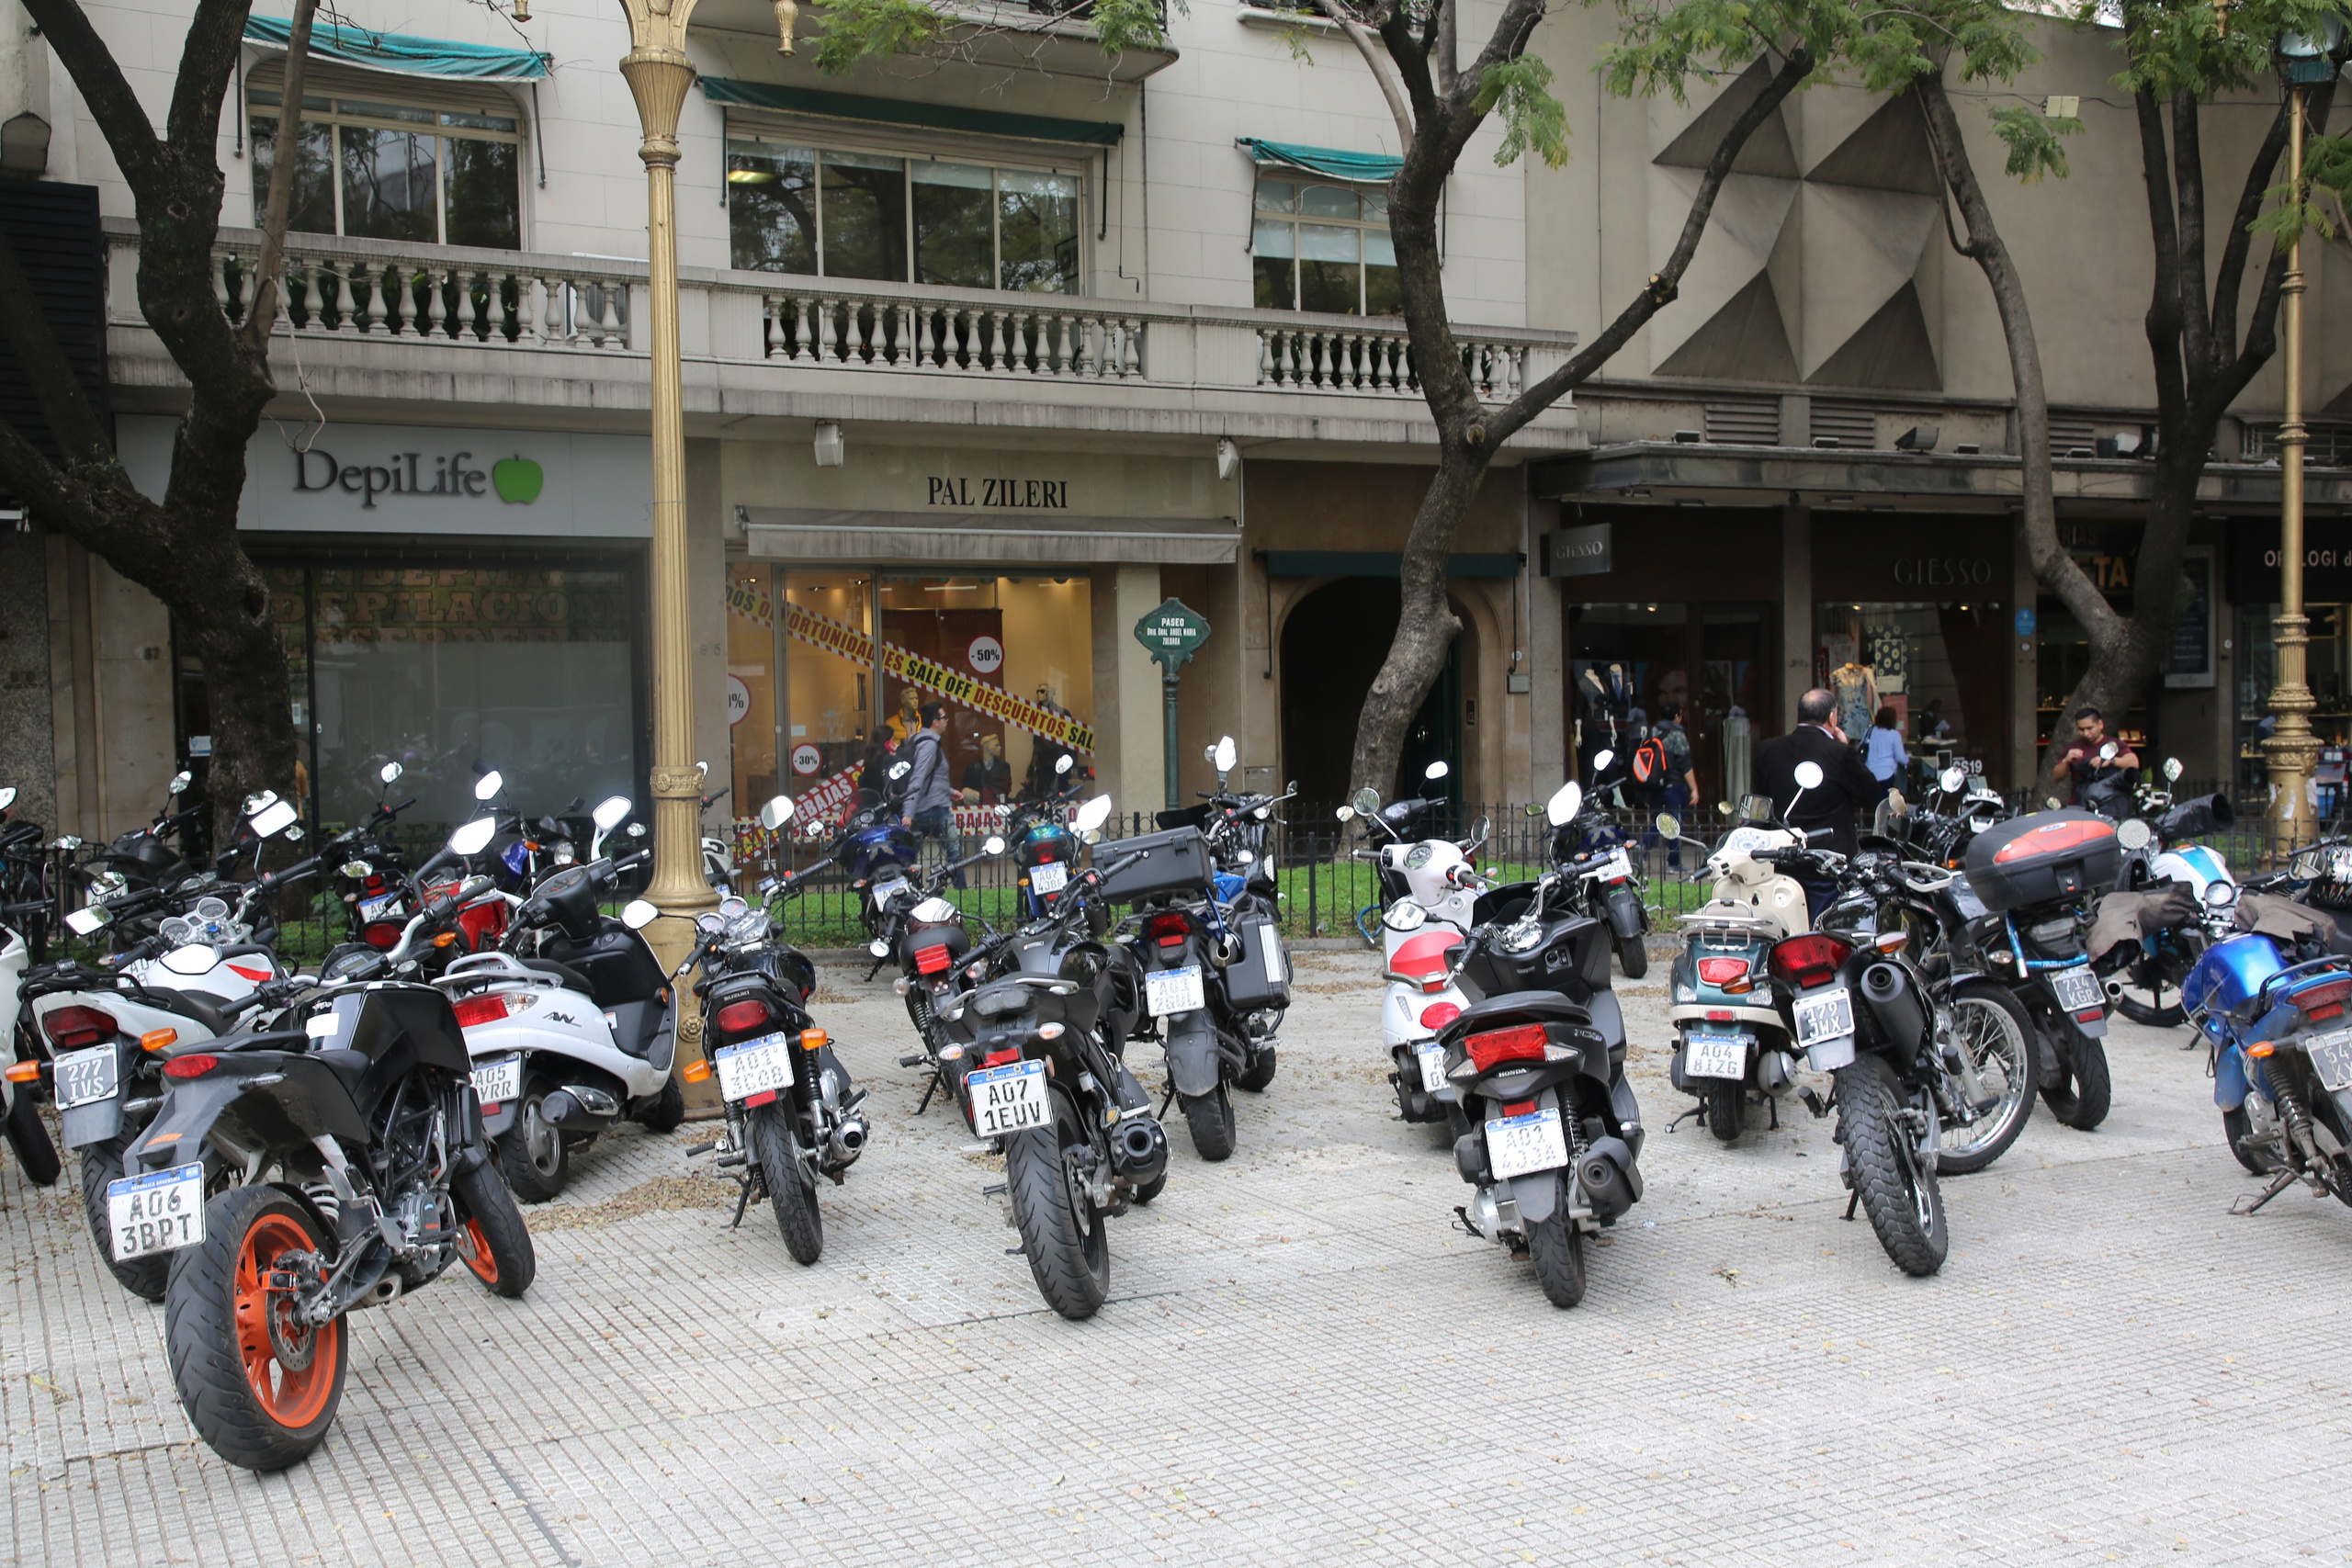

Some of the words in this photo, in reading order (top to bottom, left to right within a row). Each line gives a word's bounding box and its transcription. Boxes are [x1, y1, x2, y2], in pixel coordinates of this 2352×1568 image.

[293, 448, 487, 509] DepiLife
[927, 476, 975, 505] PAL
[982, 478, 1069, 508] ZILERI
[1556, 540, 1603, 559] GIESSO
[2264, 549, 2337, 568] OOGI
[1894, 558, 1992, 585] GIESSO
[1161, 617, 1184, 626] PASEO
[906, 660, 944, 687] SALE
[944, 676, 973, 699] OFF
[973, 686, 1067, 738] DESCUENTOS
[1068, 726, 1094, 751] SAL
[793, 777, 854, 828] EBAJAS
[953, 810, 1003, 829] BAJAS
[723, 989, 750, 1001] SUZUKI
[2062, 978, 2089, 993] 714
[2069, 989, 2096, 1006] KGR
[1805, 1001, 1838, 1024] 179
[1809, 1017, 1842, 1039] JWX
[1700, 1044, 1733, 1059] A04
[2324, 1041, 2352, 1064] 54
[68, 1058, 103, 1082] 277
[474, 1064, 506, 1084] A05
[1498, 1066, 1528, 1077] HONDA
[71, 1077, 105, 1100] IVS
[480, 1079, 512, 1100] YRR
[989, 1078, 1027, 1106] A07
[984, 1100, 1041, 1131] 1EUV
[130, 1185, 181, 1223] A06
[121, 1213, 191, 1254] 3BPT
